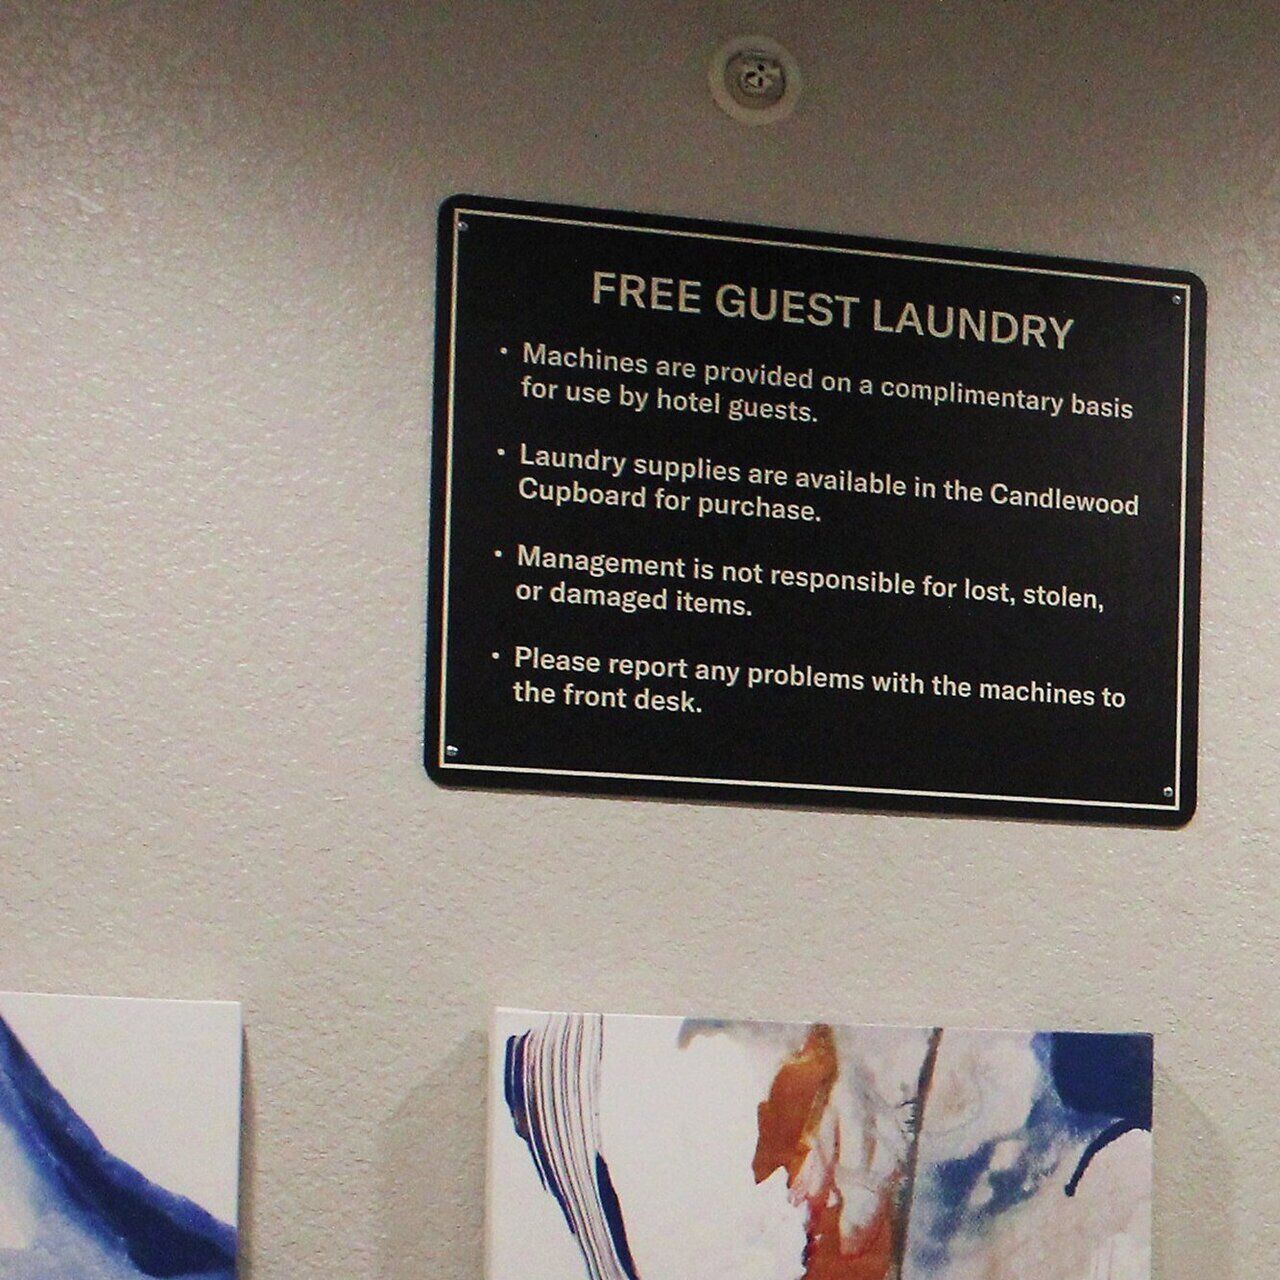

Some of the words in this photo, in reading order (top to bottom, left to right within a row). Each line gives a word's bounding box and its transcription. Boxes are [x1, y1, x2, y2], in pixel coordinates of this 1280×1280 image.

[593, 271, 702, 314] FREE
[715, 283, 861, 329] GUEST
[873, 298, 1075, 350] LAUNDRY
[520, 374, 559, 400] for
[566, 385, 611, 405] use
[619, 383, 649, 413] by
[656, 387, 721, 415] hotel
[727, 398, 818, 423] guests.
[523, 341, 648, 375] Machines
[655, 359, 696, 379] are
[704, 363, 814, 390] provided
[821, 375, 852, 393] on
[858, 378, 873, 396] a
[880, 380, 1065, 418] complimentary
[1071, 392, 1134, 420] basis
[518, 476, 647, 509] Cupboard
[654, 487, 692, 512] for
[697, 495, 822, 523] purchase.
[520, 442, 627, 478] Laundry
[633, 457, 742, 484] supplies
[747, 467, 788, 487] are
[795, 469, 907, 497] available
[914, 475, 937, 499] in
[942, 478, 984, 503] the
[989, 482, 1140, 517] Candlewood
[515, 583, 544, 601] or
[549, 580, 668, 614] damaged
[676, 589, 753, 617] items.
[517, 543, 686, 579] Management
[693, 557, 715, 581] is
[722, 563, 764, 585] not
[770, 568, 916, 596] responsible
[921, 574, 958, 599] for
[964, 577, 1016, 607] lost,
[1022, 584, 1104, 614] stolen,
[511, 679, 556, 705] the
[562, 682, 628, 709] front
[633, 687, 703, 714] desk.
[514, 645, 601, 674] Please
[608, 657, 689, 682] report
[694, 663, 741, 688] any
[747, 663, 865, 691] problems
[871, 671, 925, 695] with
[930, 673, 972, 698] the
[979, 680, 1096, 707] machines
[1100, 686, 1127, 709] to
